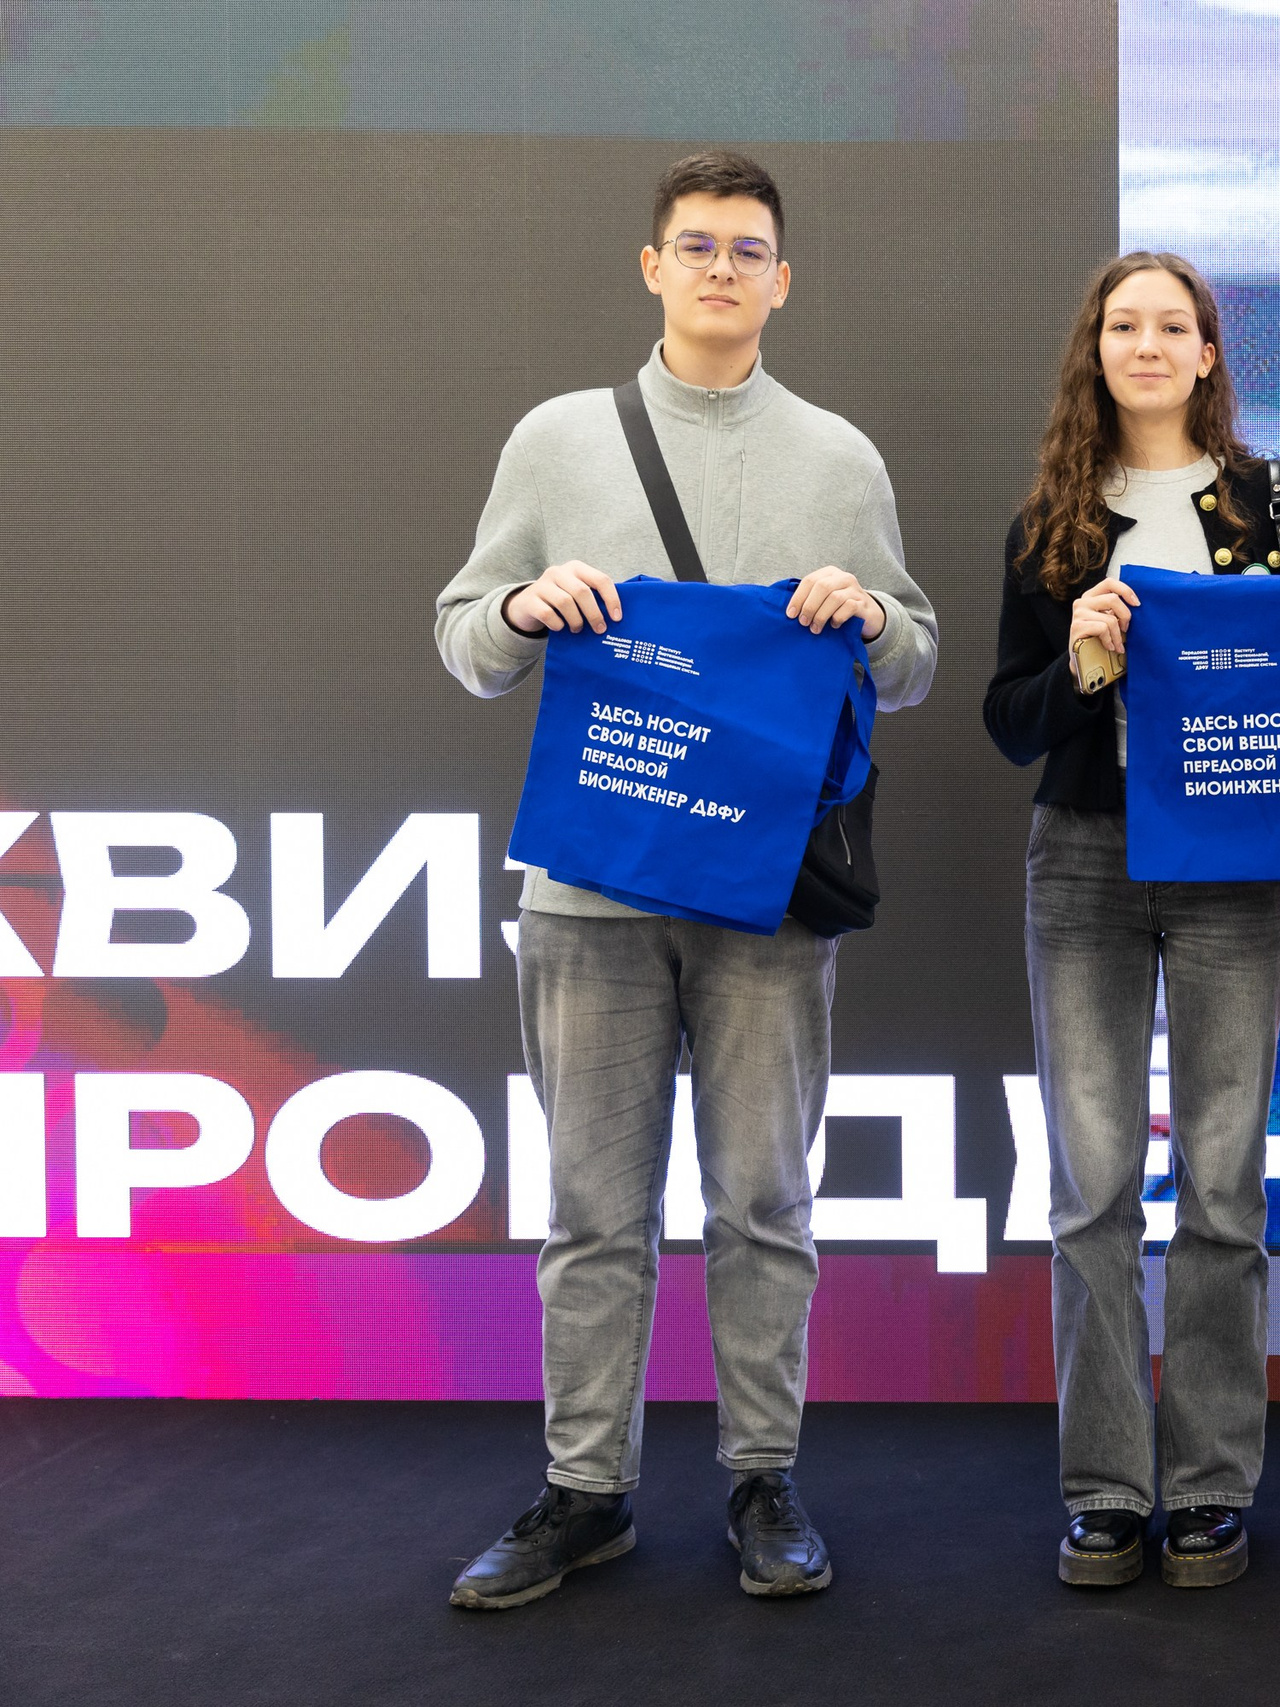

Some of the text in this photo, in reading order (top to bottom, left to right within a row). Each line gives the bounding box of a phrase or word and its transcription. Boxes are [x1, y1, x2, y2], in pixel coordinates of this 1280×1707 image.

[590, 702, 711, 743] ЗДЕСЬ НОСИТ
[1182, 715, 1238, 733] ЗДЕСЬ
[588, 724, 688, 760] СВОИ ВЕЩИ
[1182, 736, 1234, 753] СВОИ
[582, 747, 668, 779] ПЕРЕДОВОЙ
[1184, 754, 1276, 774] ПЕРЕДОВОЙ
[578, 770, 746, 824] БИОИНЖЕНЕР ДВФУ
[0, 812, 525, 978] ВИ
